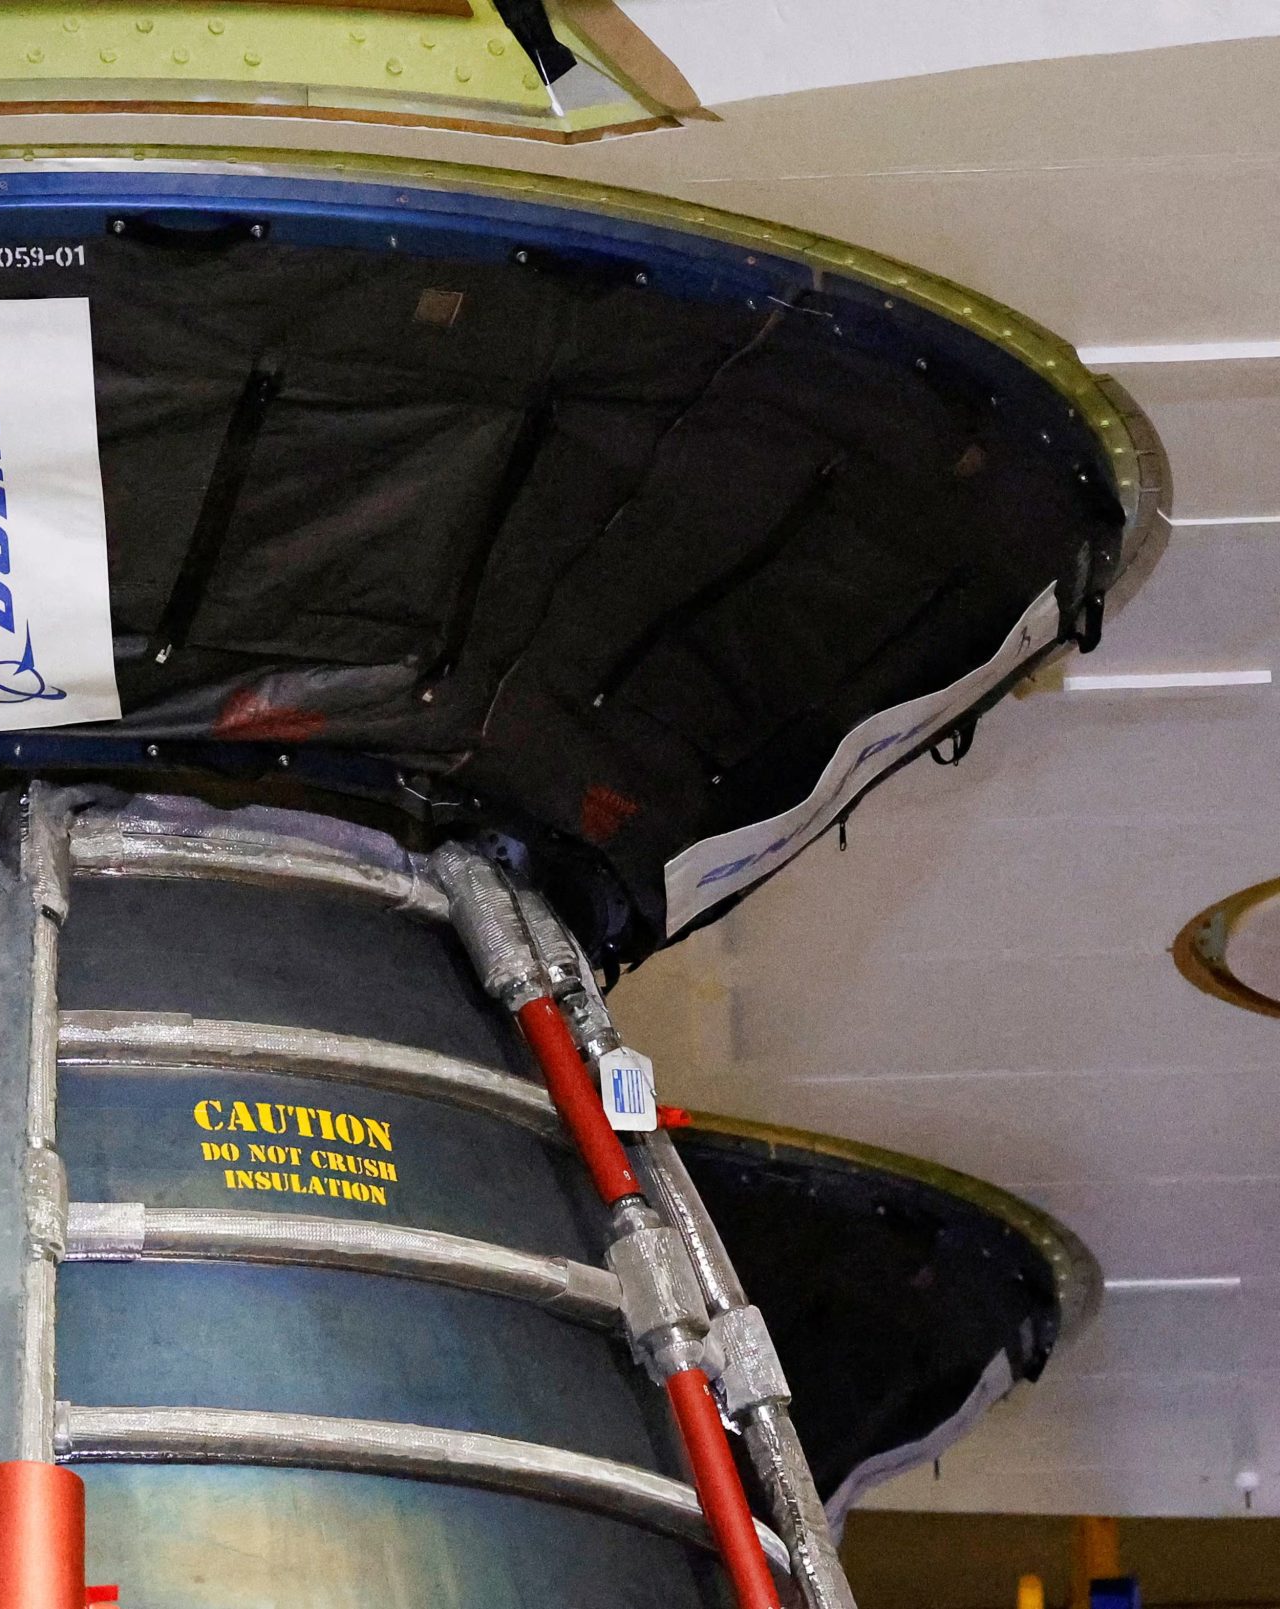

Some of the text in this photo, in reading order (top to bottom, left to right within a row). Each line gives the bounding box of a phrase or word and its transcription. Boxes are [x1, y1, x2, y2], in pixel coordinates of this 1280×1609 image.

[193, 1099, 393, 1152] CAUTION
[201, 1141, 398, 1182] DO NOT CRUSH
[223, 1169, 387, 1206] INSULATION
